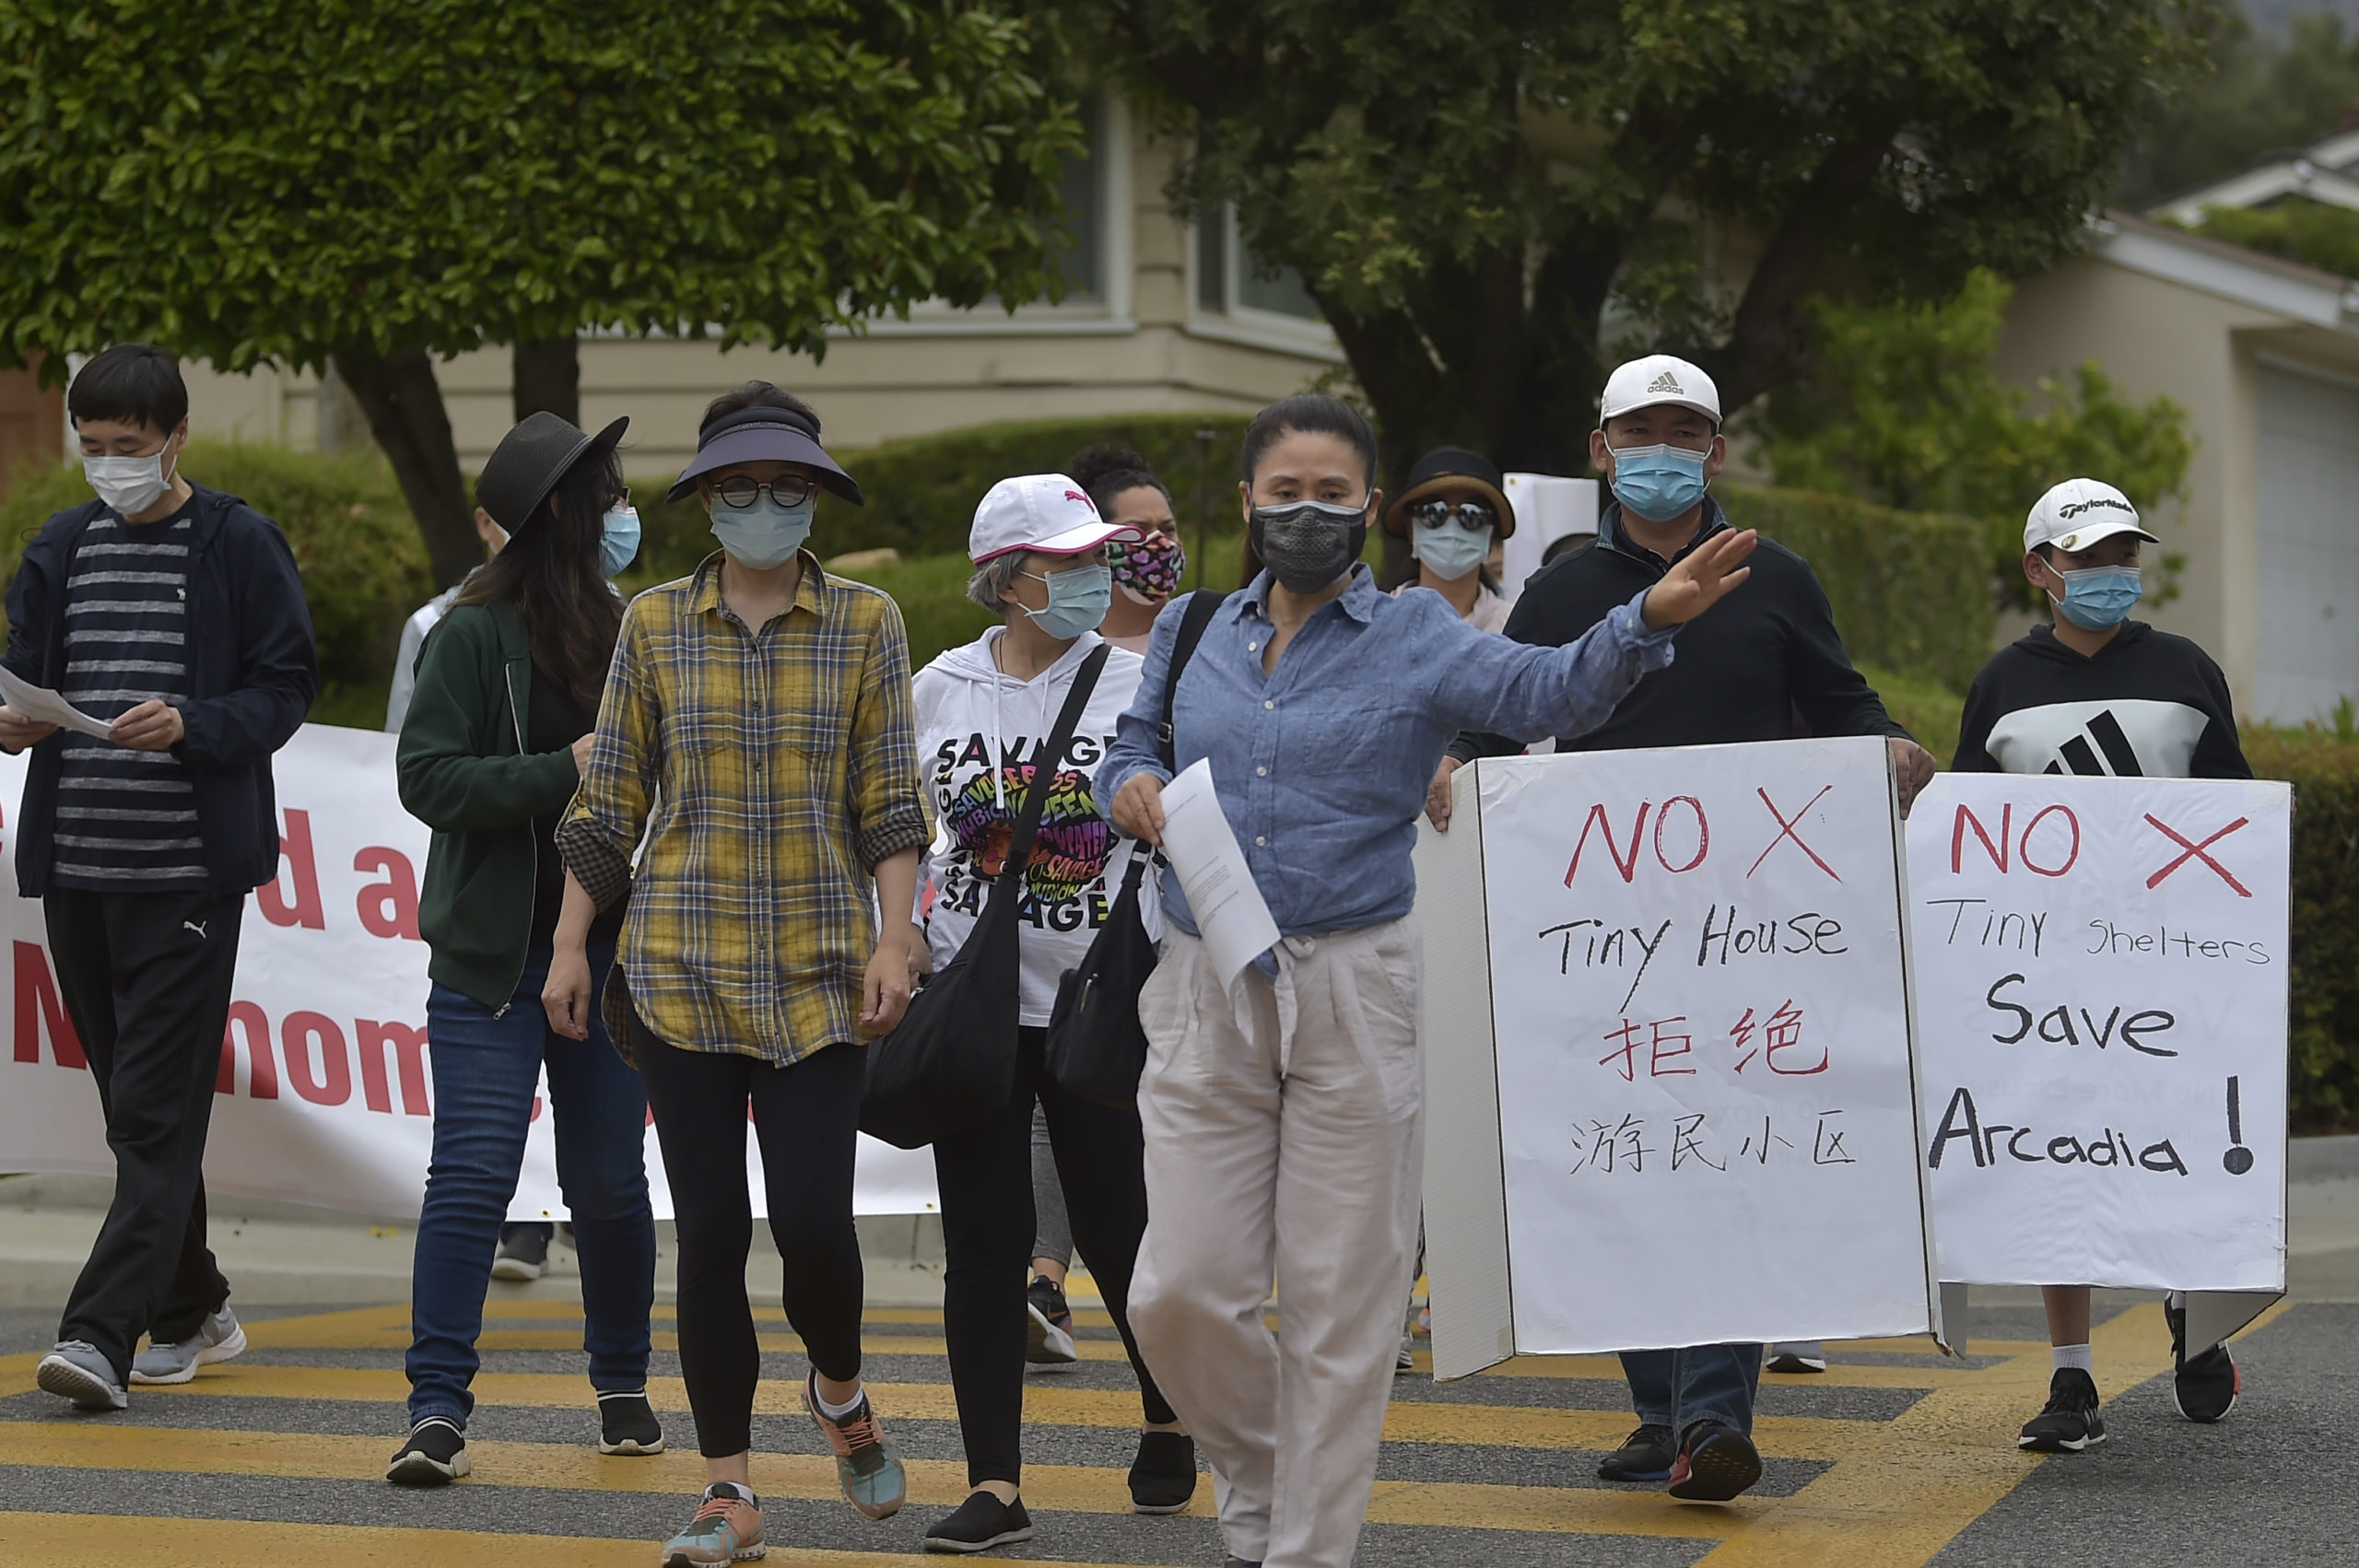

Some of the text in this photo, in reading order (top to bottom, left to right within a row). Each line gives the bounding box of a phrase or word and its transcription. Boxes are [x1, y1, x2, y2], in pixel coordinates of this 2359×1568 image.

[1647, 384, 1684, 395] adidas
[1036, 820, 1108, 860] DUCATED
[1565, 796, 1709, 888] NO
[1951, 802, 2080, 877] NO
[940, 878, 1109, 931] SAAGE
[1926, 898, 2048, 958] Tiny
[1539, 903, 1848, 1016] Tiny House
[1599, 998, 1829, 1082] 拒绝
[1986, 973, 2178, 1058] Save
[1569, 1109, 1857, 1176] 游民小区
[1928, 1086, 2189, 1177] Arcadia
